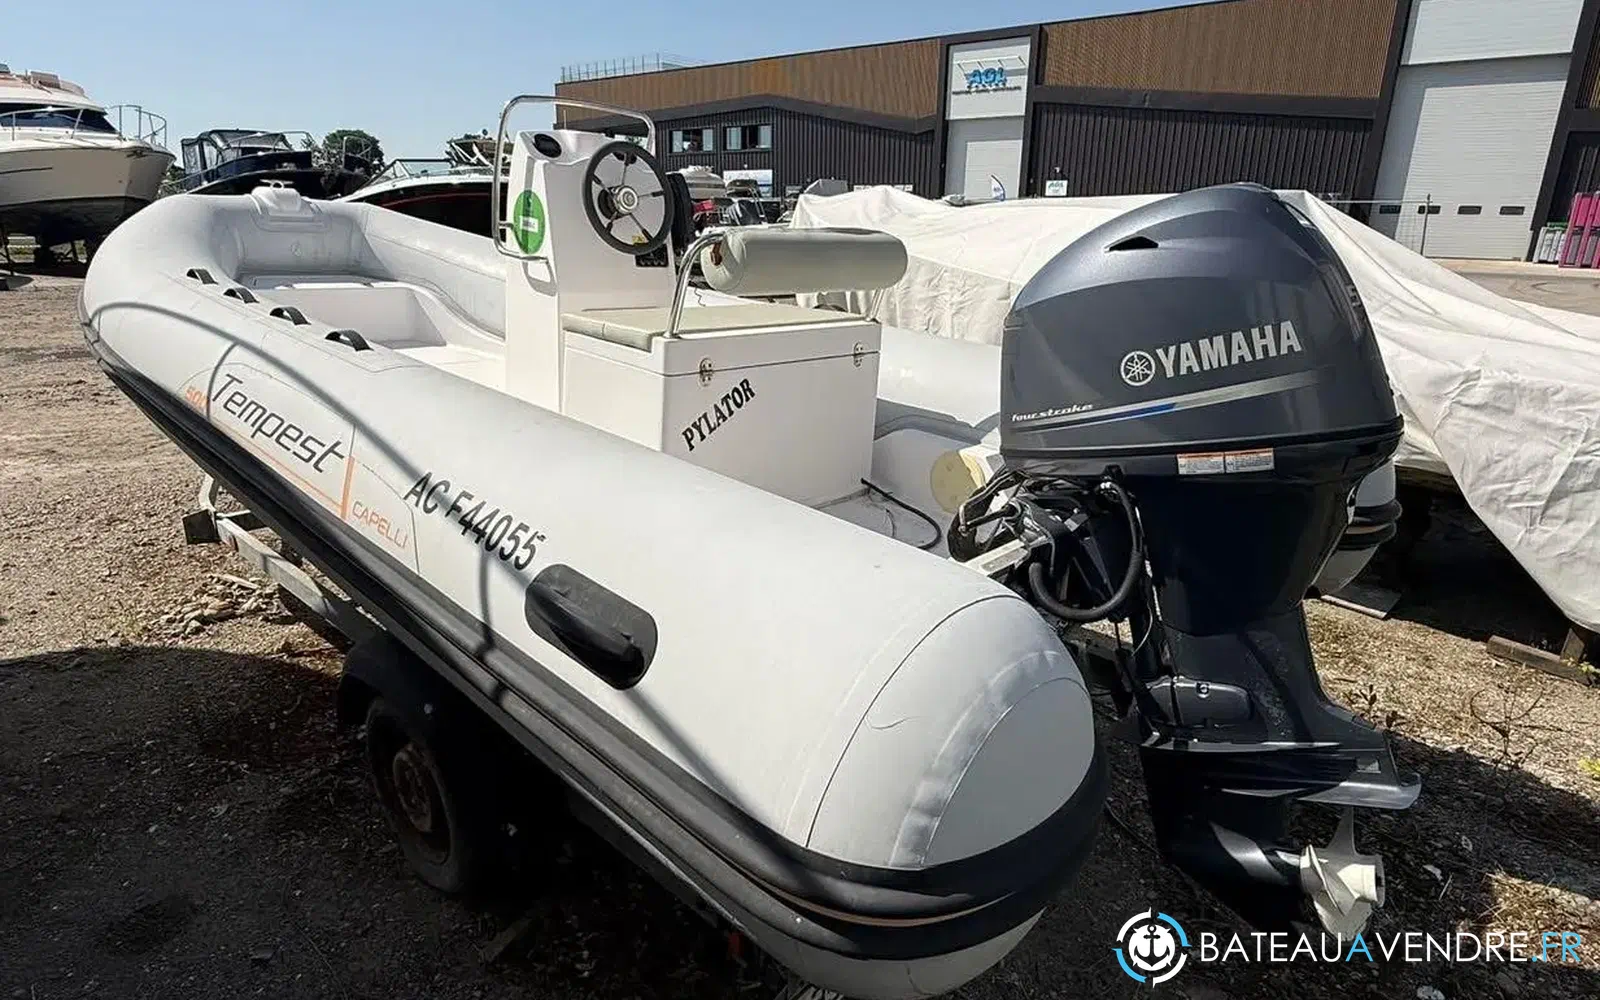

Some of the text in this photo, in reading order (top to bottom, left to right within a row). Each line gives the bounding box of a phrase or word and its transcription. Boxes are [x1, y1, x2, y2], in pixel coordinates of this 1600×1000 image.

[1156, 320, 1302, 378] YAMAHA
[212, 373, 345, 473] Tempest
[682, 378, 756, 452] PYLATOR
[352, 501, 408, 549] CAPELLI
[403, 471, 547, 570] AC F44055
